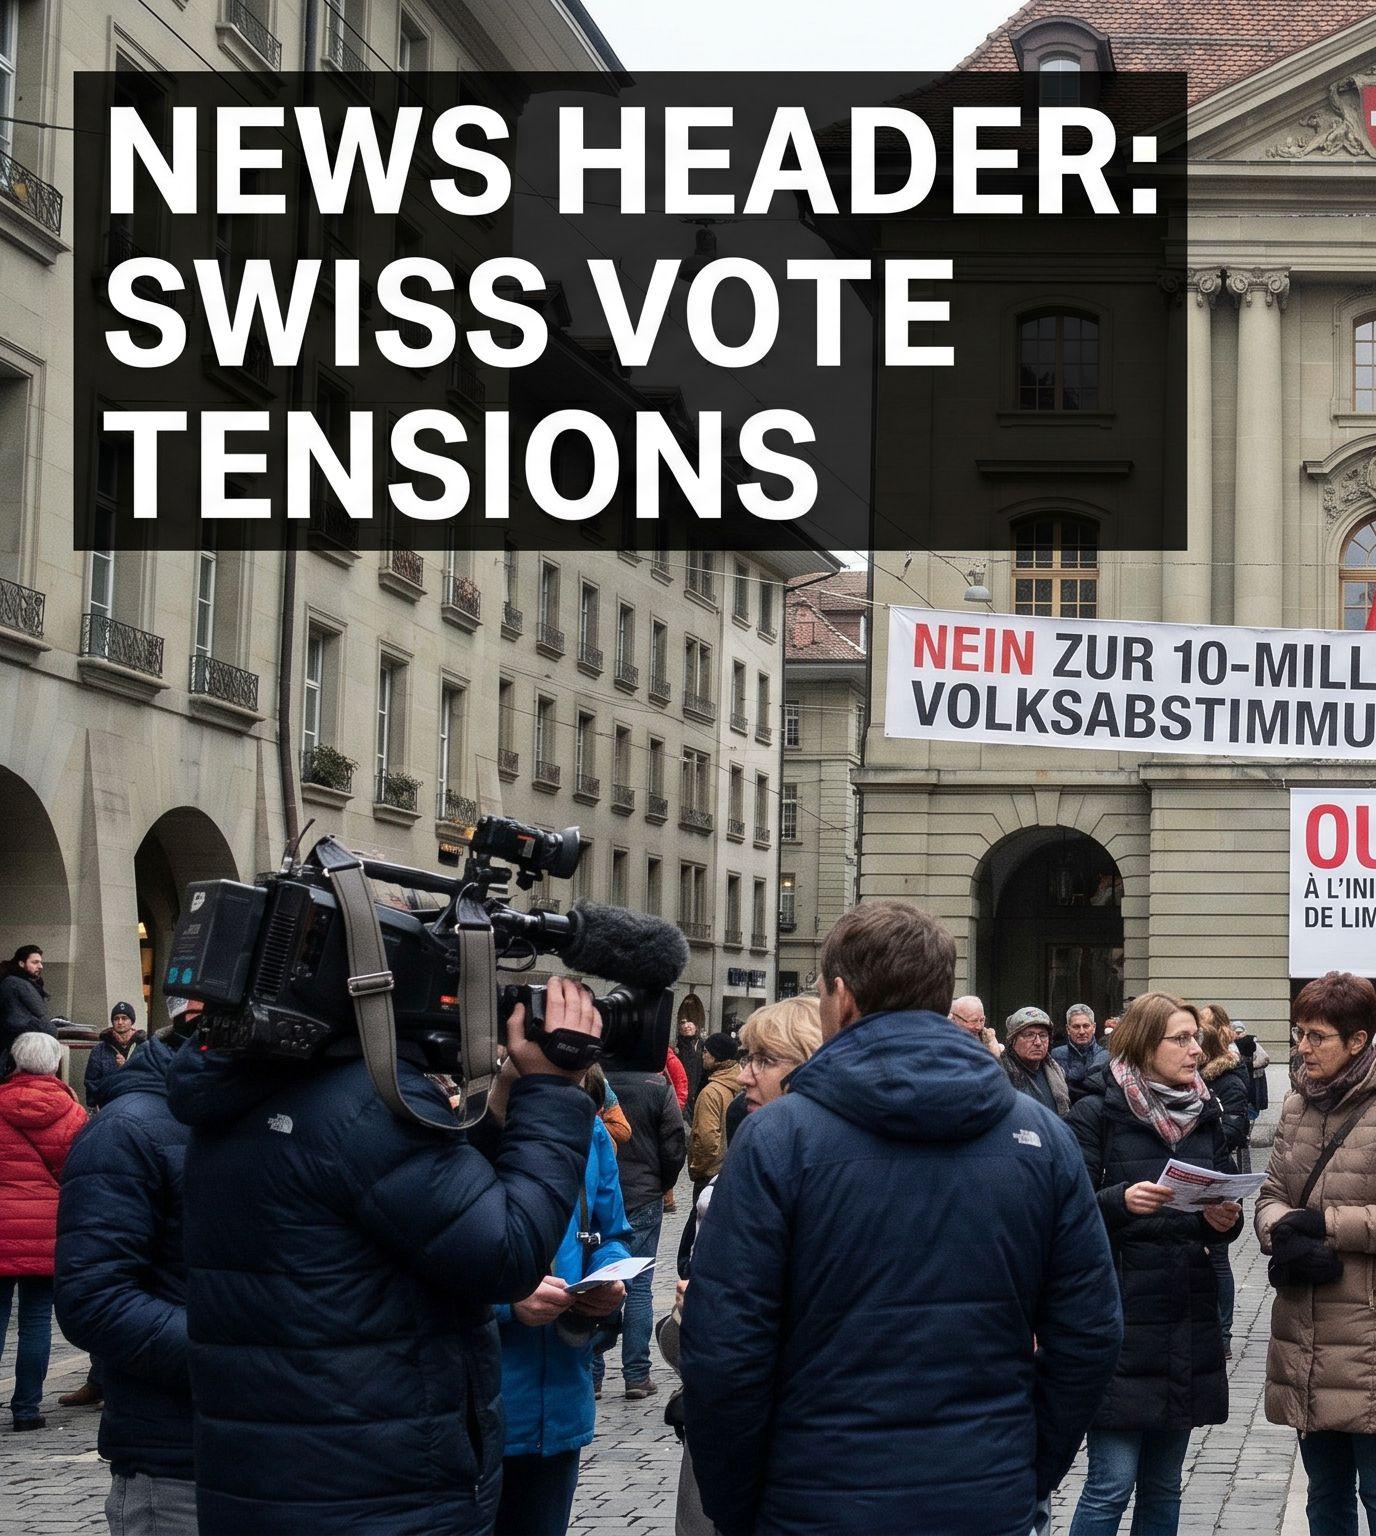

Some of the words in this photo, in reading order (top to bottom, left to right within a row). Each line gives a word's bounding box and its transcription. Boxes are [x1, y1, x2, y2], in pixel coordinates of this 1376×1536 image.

[914, 623, 1035, 676] NEIN
[1052, 632, 1154, 682] ZUR
[1304, 872, 1320, 899] À
[1304, 906, 1333, 928] DE
